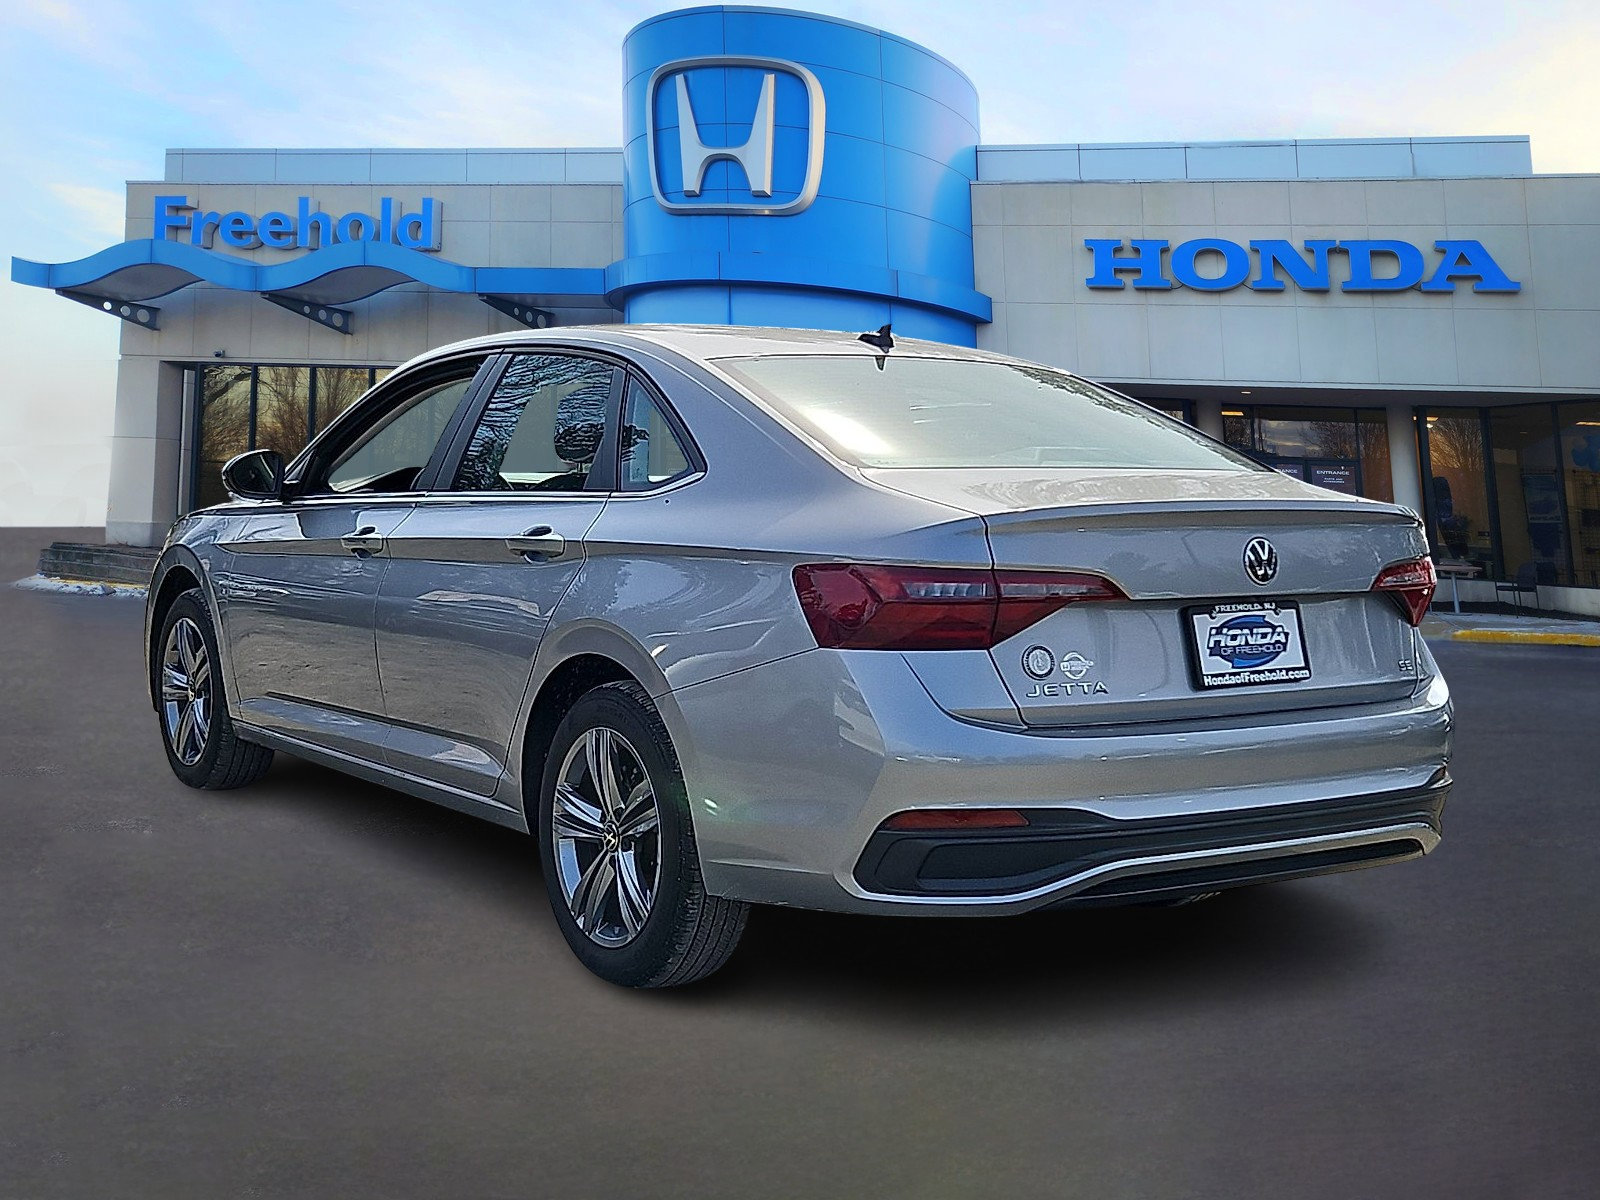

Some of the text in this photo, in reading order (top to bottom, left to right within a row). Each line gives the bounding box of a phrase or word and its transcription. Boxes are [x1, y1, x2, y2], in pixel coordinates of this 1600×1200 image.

[154, 195, 436, 250] Freehold
[1084, 239, 1521, 293] HONDA
[1263, 602, 1276, 610] NJ
[1208, 627, 1287, 647] HONDA
[1221, 643, 1284, 655] OF FREEHOLD
[1203, 669, 1310, 687] HondaofFreehold.com
[1026, 682, 1109, 698] JETTA
